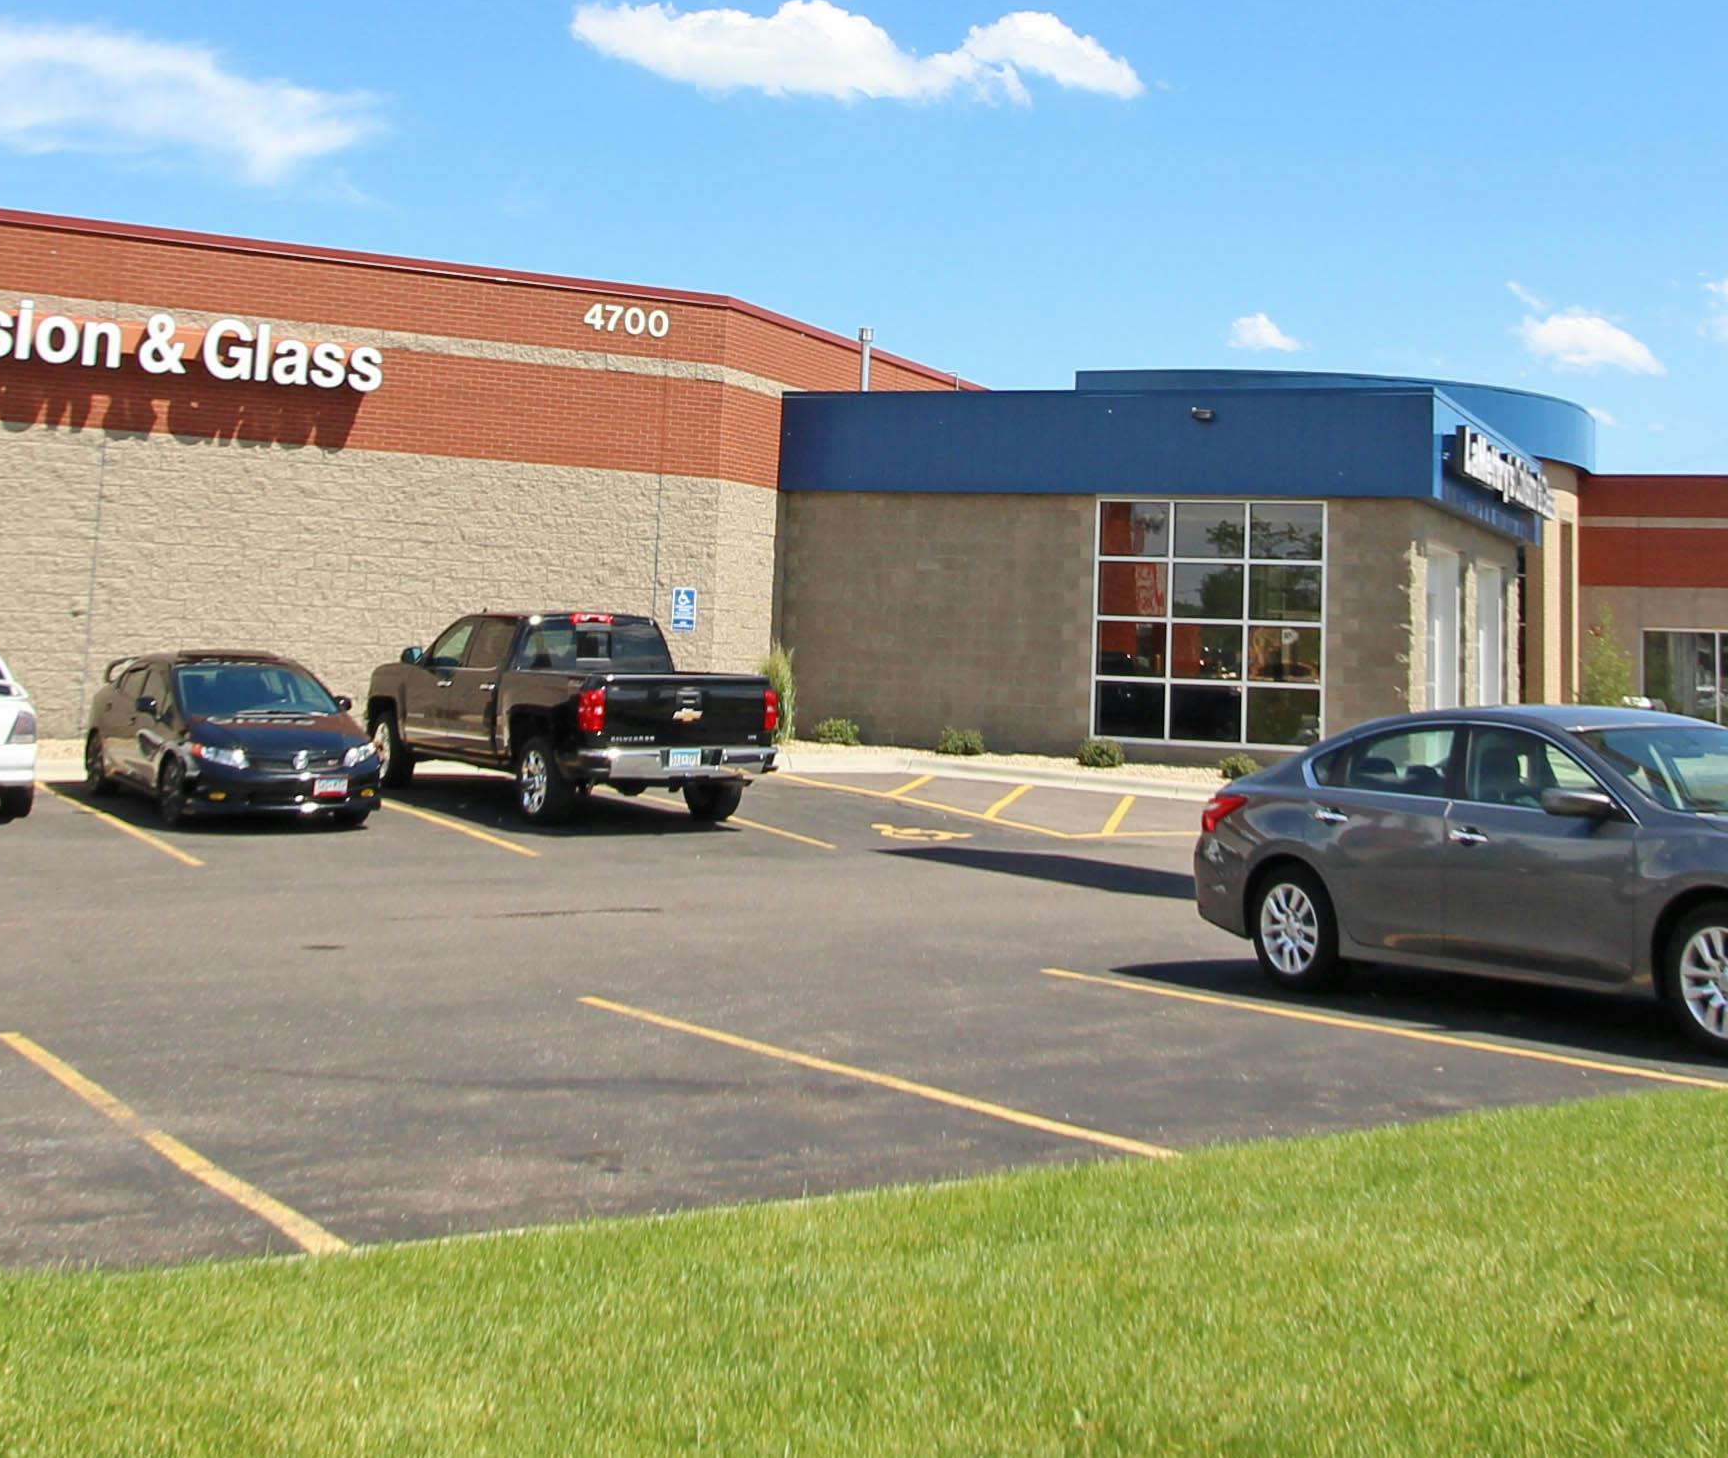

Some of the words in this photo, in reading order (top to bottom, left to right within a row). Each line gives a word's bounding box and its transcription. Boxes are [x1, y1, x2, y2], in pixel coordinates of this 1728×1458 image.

[583, 303, 670, 338] 4700
[139, 312, 186, 374] &
[204, 318, 384, 392] Glass
